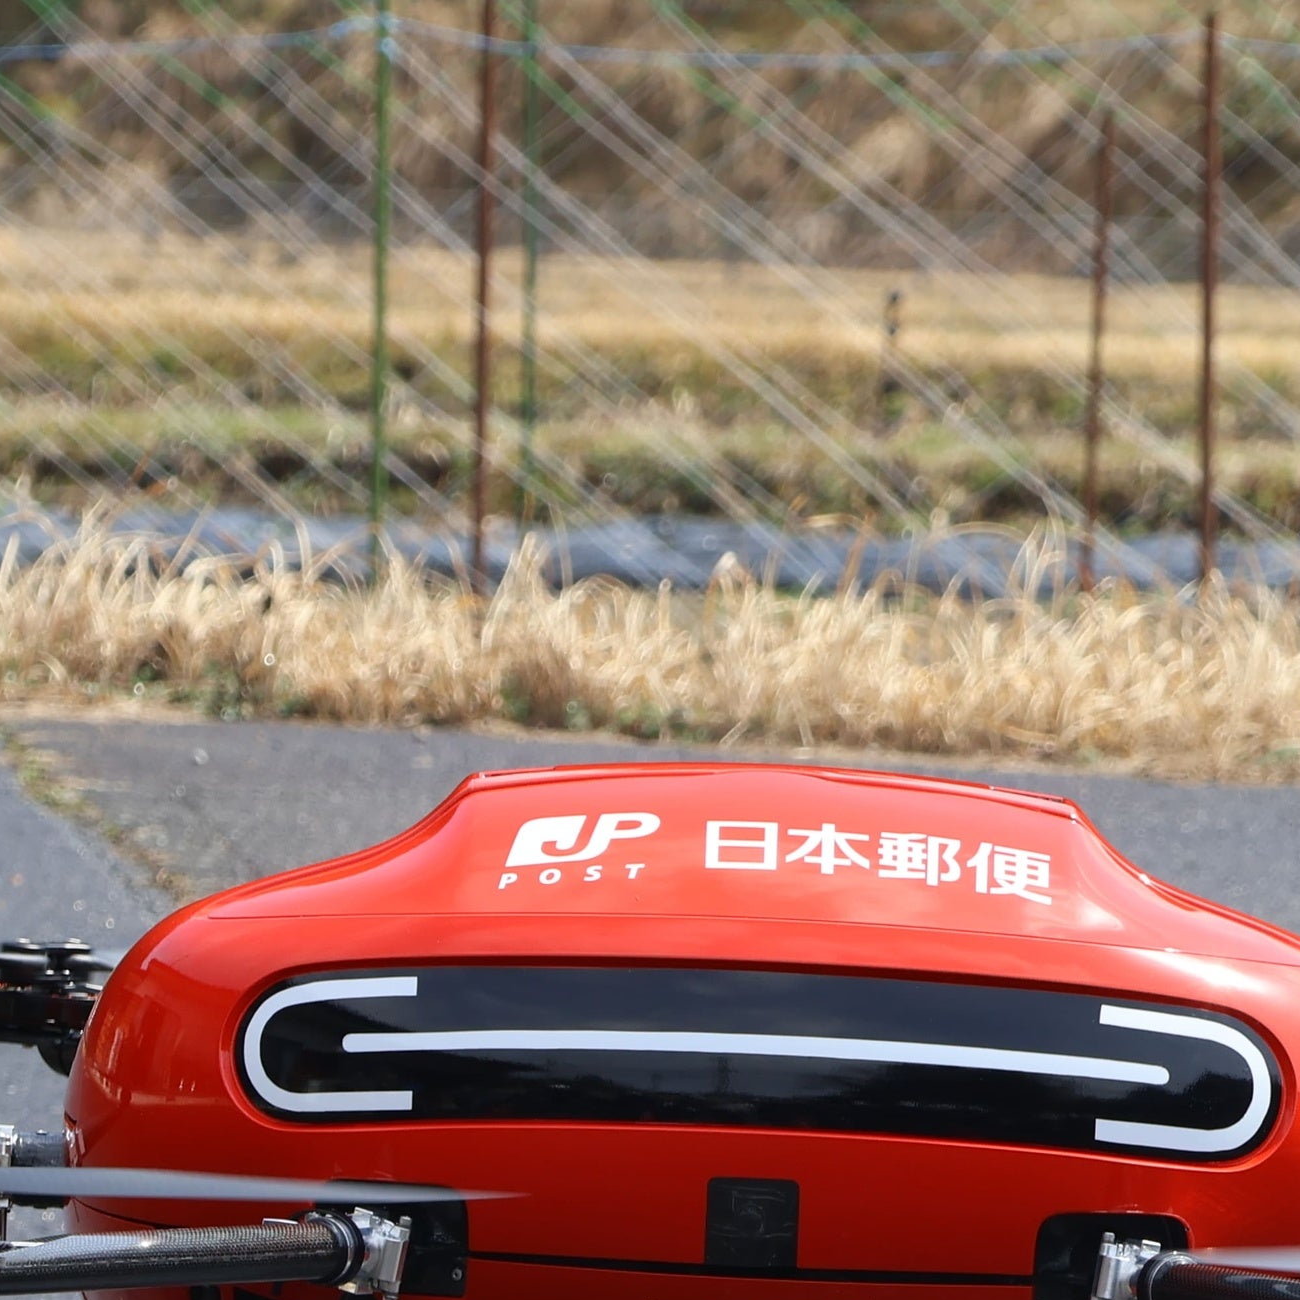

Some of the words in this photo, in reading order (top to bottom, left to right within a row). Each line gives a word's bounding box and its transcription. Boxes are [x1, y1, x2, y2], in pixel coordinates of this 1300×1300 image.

[499, 863, 645, 889] POST
[705, 820, 1052, 905] 日本郵便
